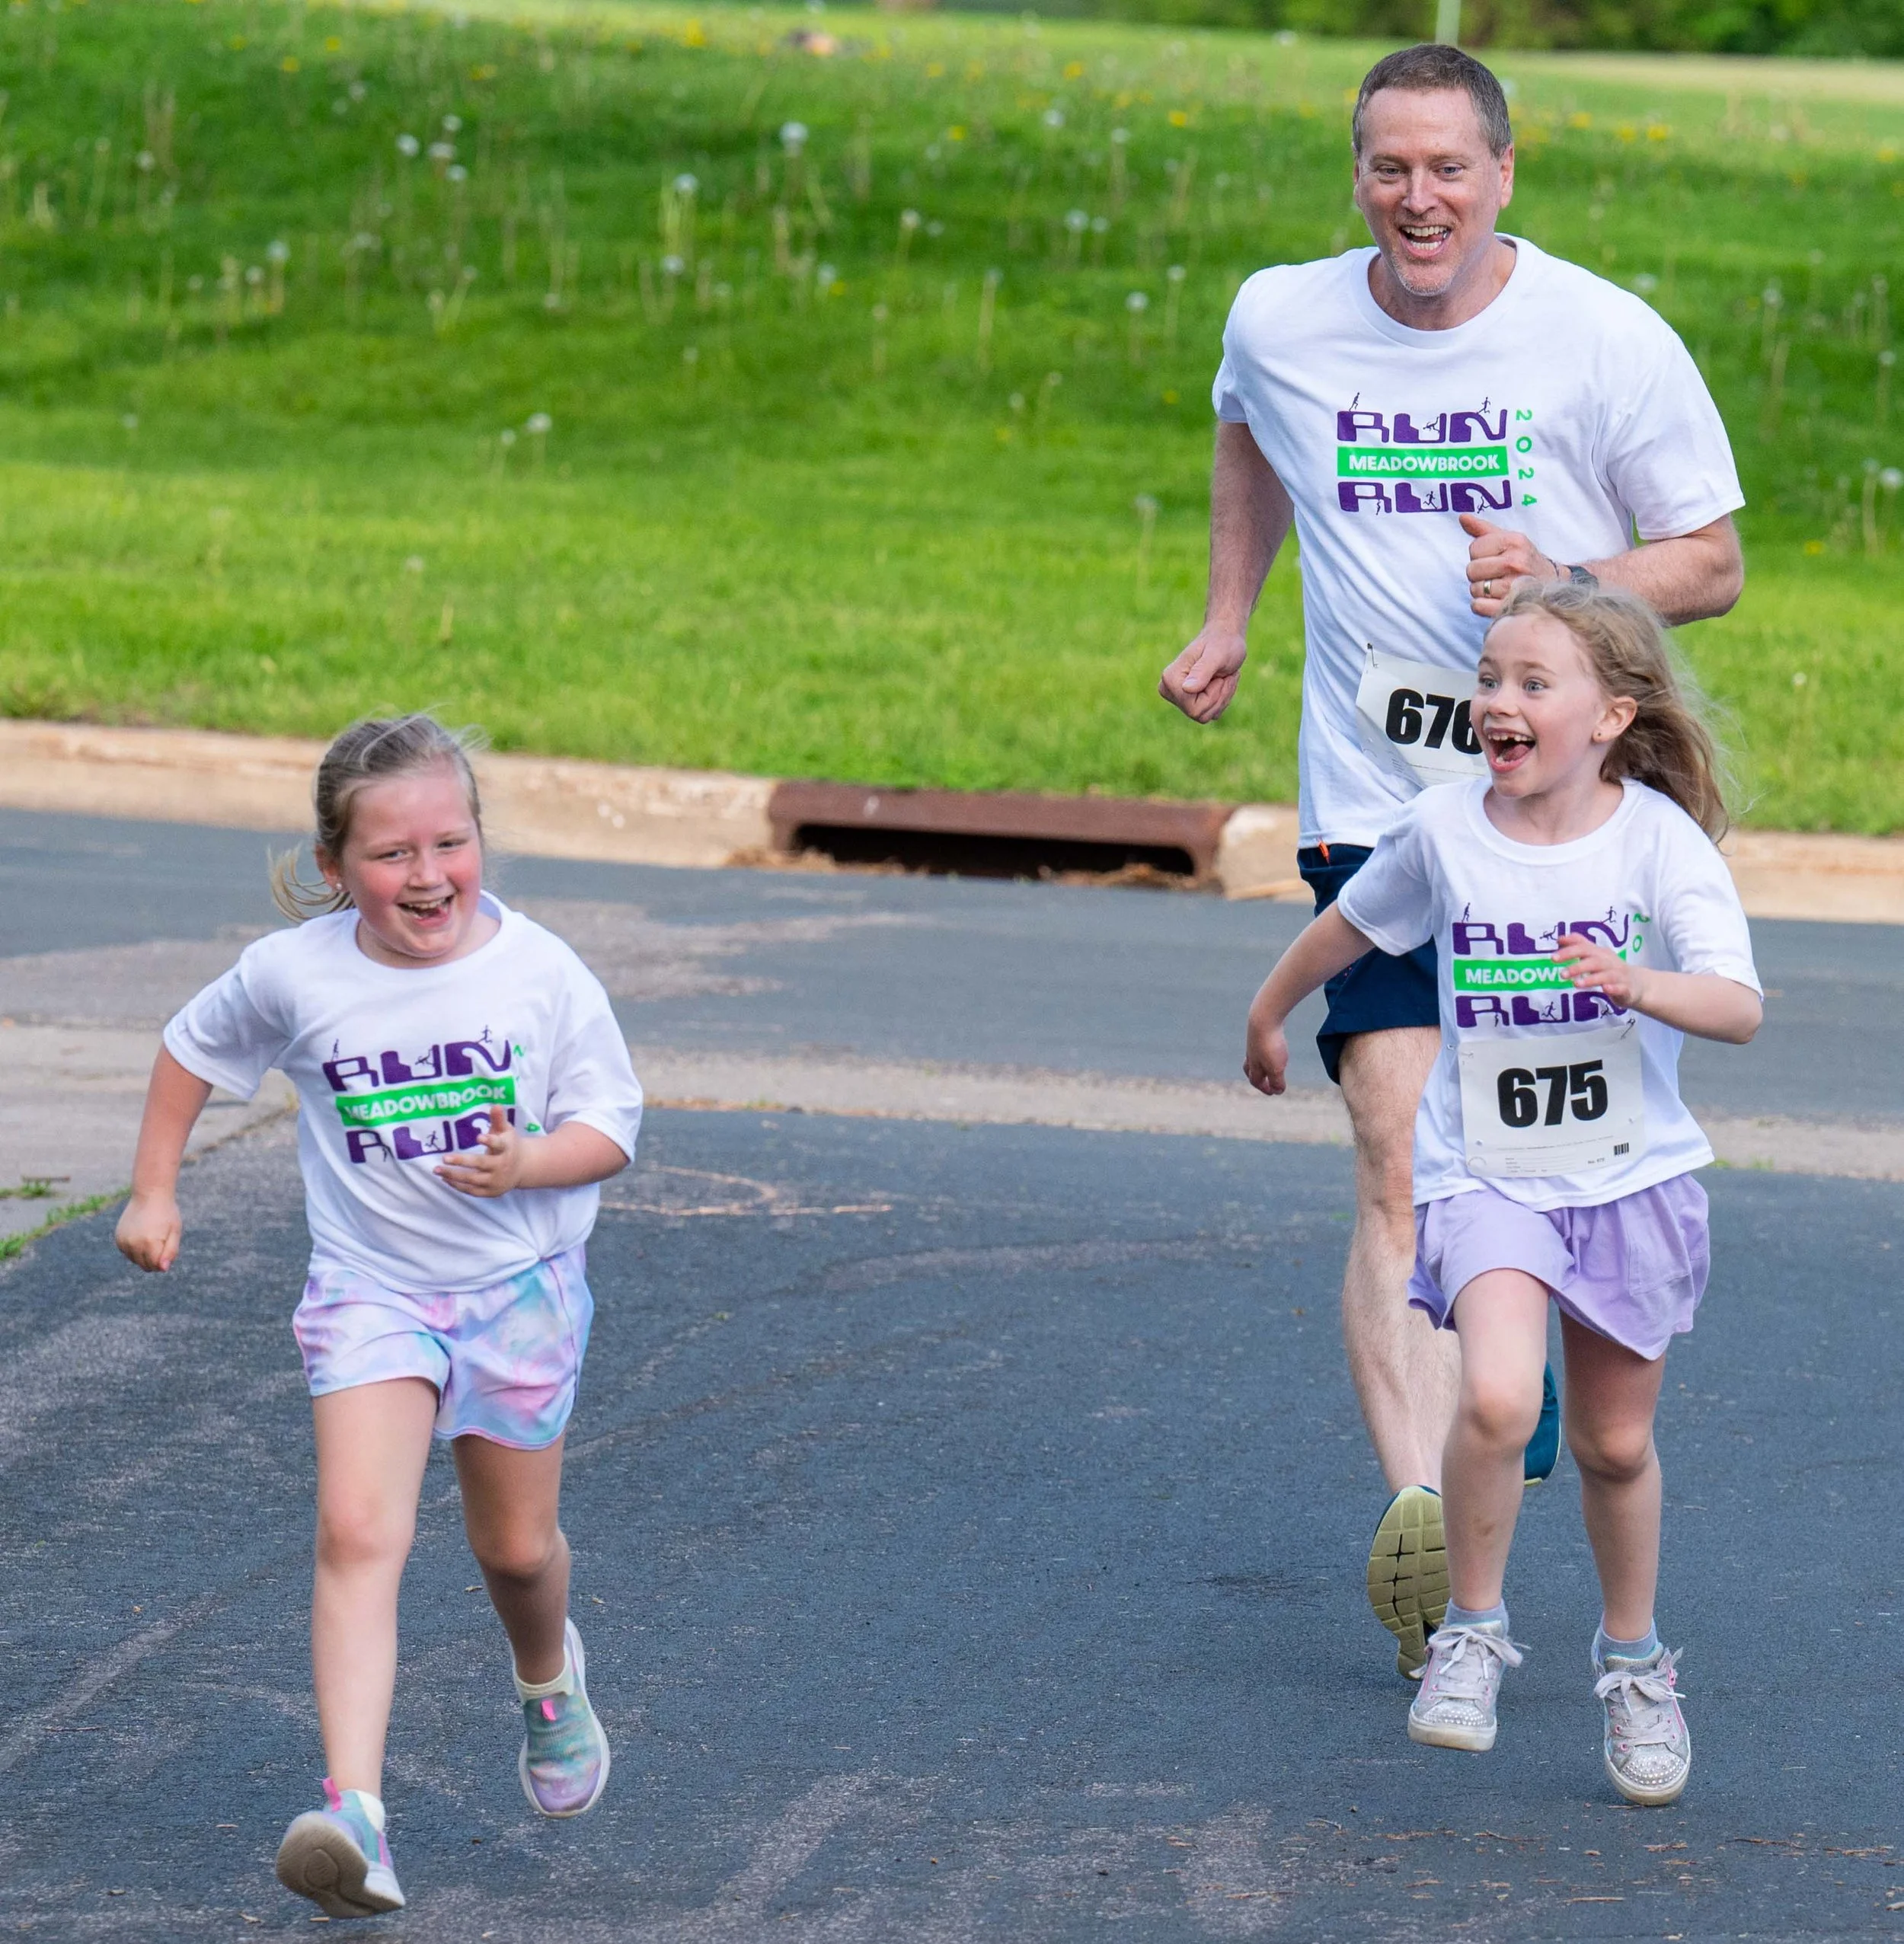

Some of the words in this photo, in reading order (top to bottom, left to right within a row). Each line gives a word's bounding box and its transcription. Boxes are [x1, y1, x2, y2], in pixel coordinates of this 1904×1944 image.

[1337, 409, 1507, 443] RUN
[1349, 454, 1500, 472] MEADOWBROOK
[1515, 409, 1538, 506] 2024
[1338, 480, 1512, 512] RUN
[1452, 914, 1628, 955] RUN
[1632, 912, 1651, 953] 20
[1465, 966, 1572, 985] MEADOW
[1455, 991, 1628, 1028] RUN
[323, 1039, 511, 1091] RUN
[344, 1084, 506, 1121] MEADOWBROOK
[1497, 1059, 1608, 1128] 675
